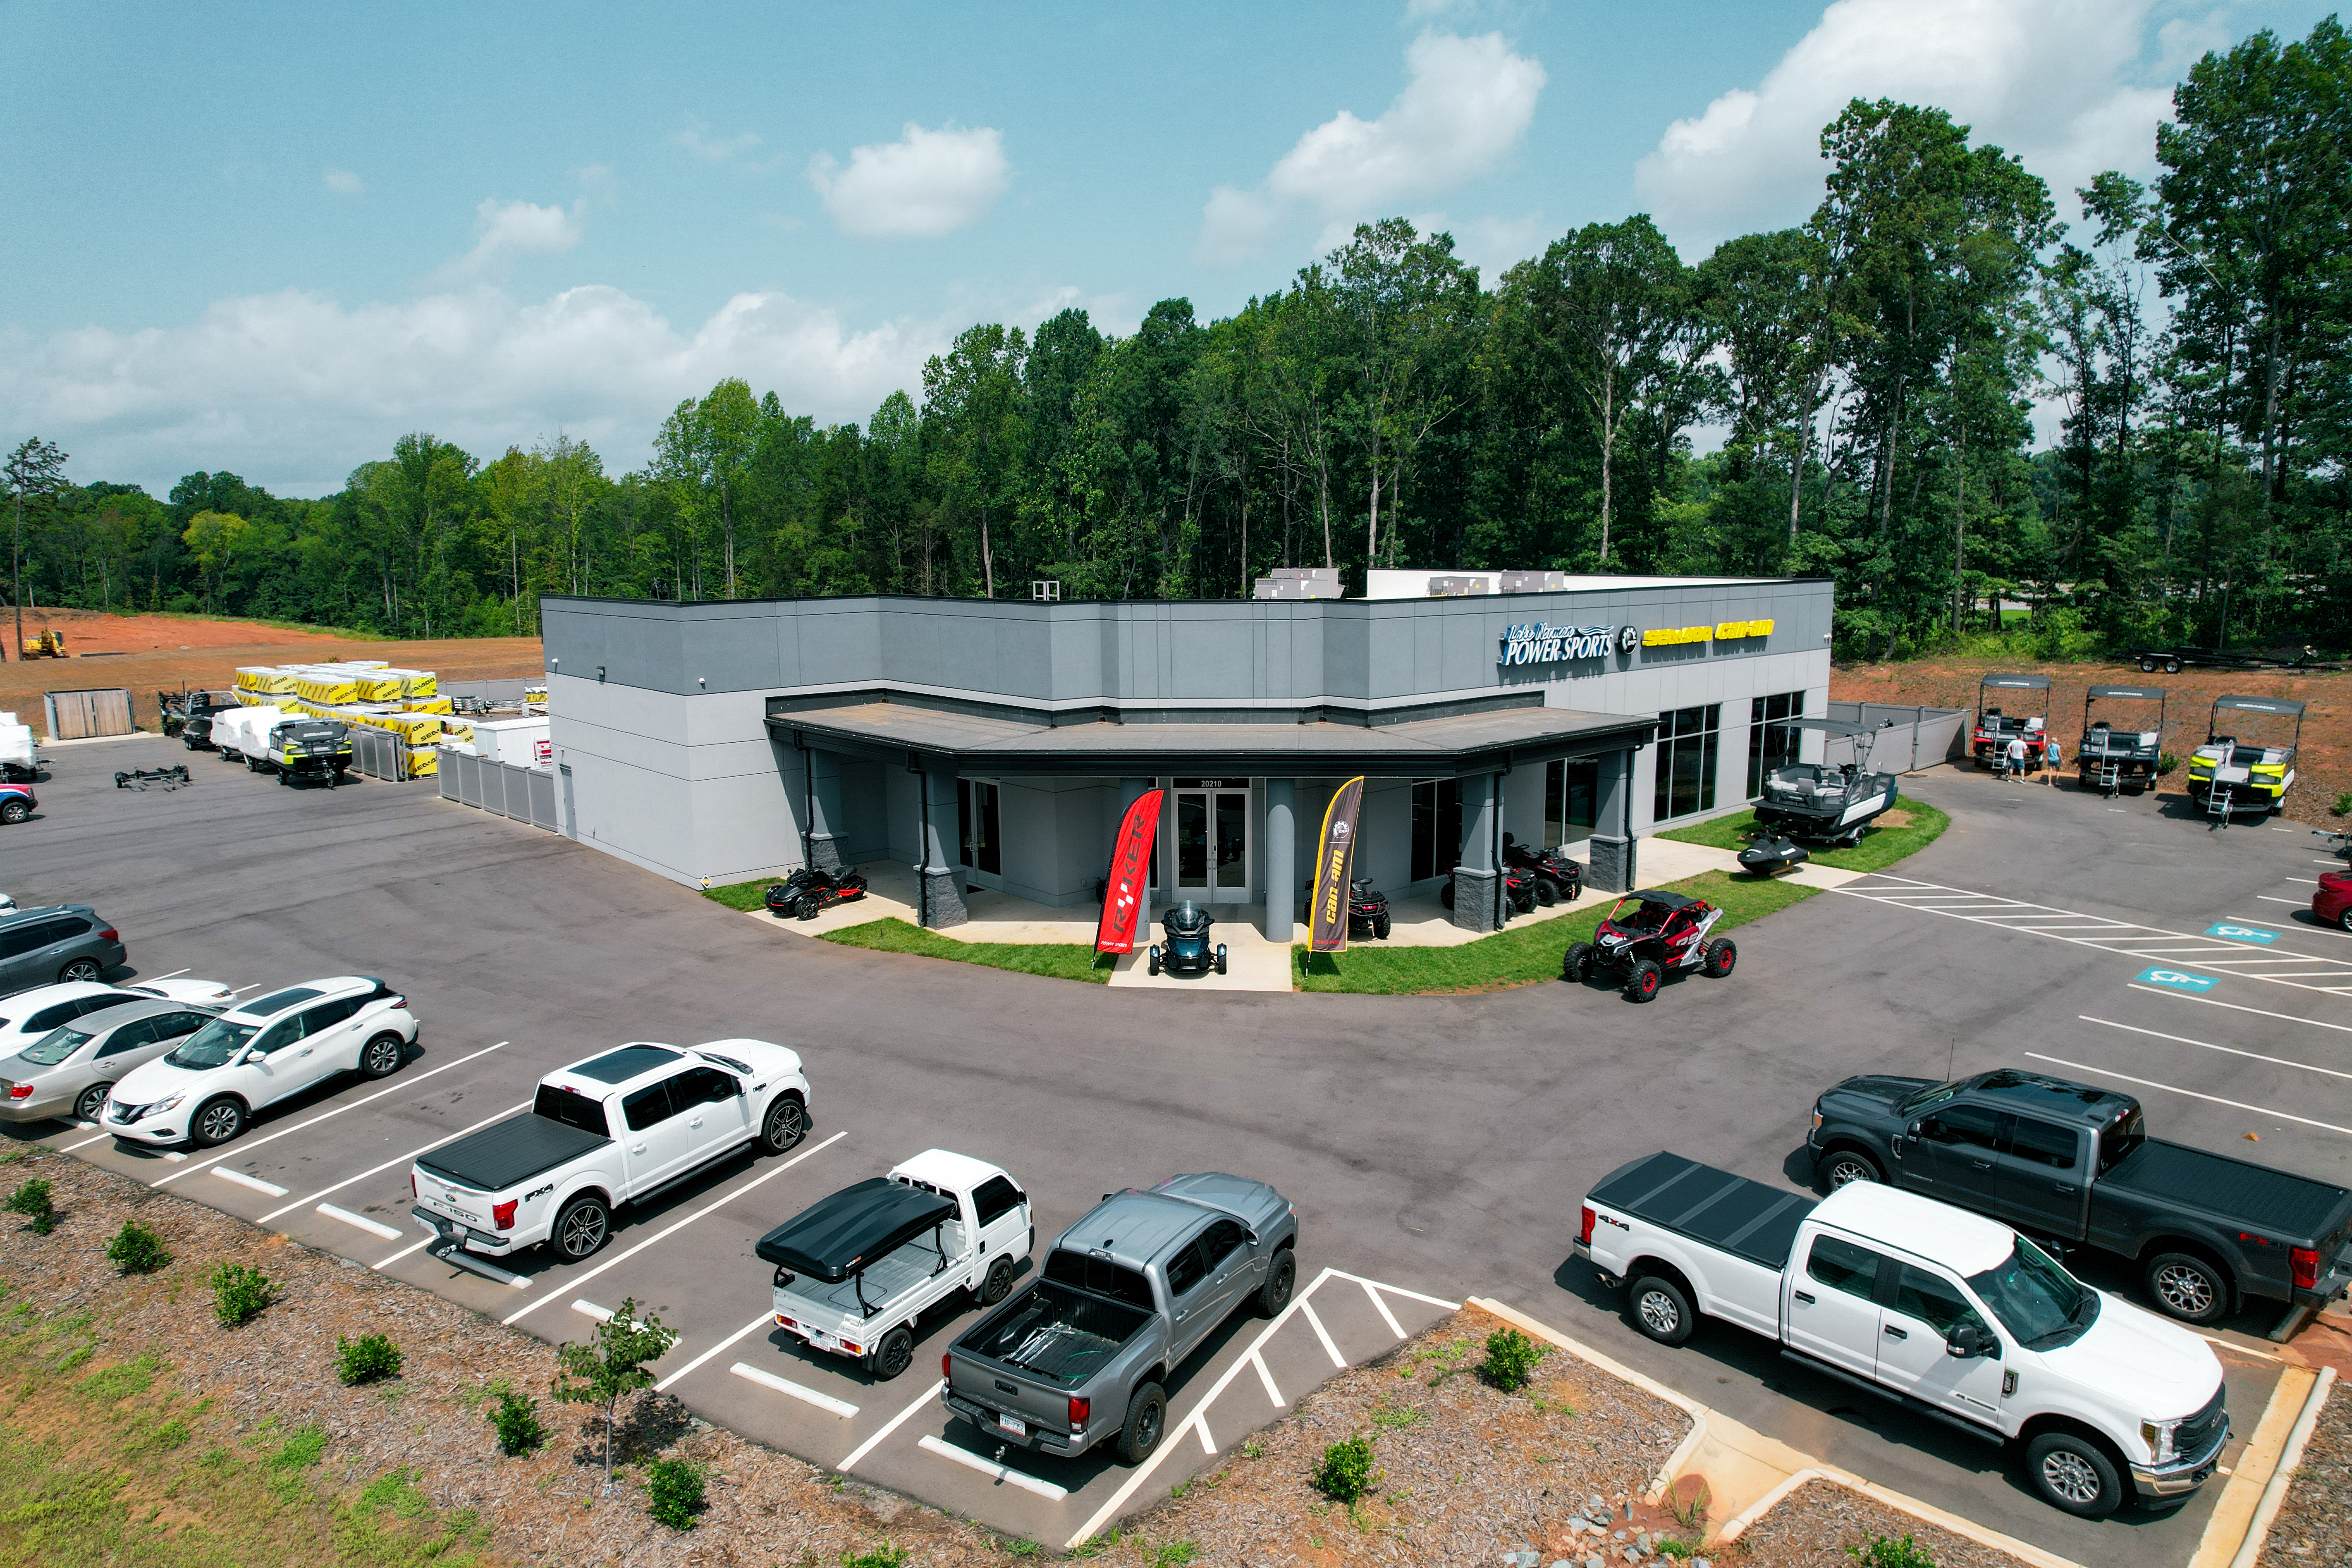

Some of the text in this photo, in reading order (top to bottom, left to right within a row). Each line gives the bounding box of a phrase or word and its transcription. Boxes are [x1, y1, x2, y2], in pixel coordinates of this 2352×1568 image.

[1508, 622, 1575, 643] Lake Norman
[1505, 634, 1614, 666] POWER SPORTS
[524, 1183, 554, 1203] FX4
[433, 1201, 478, 1223] F-150
[2239, 1232, 2283, 1250] FX4
[976, 1395, 1044, 1424] TACOMA
